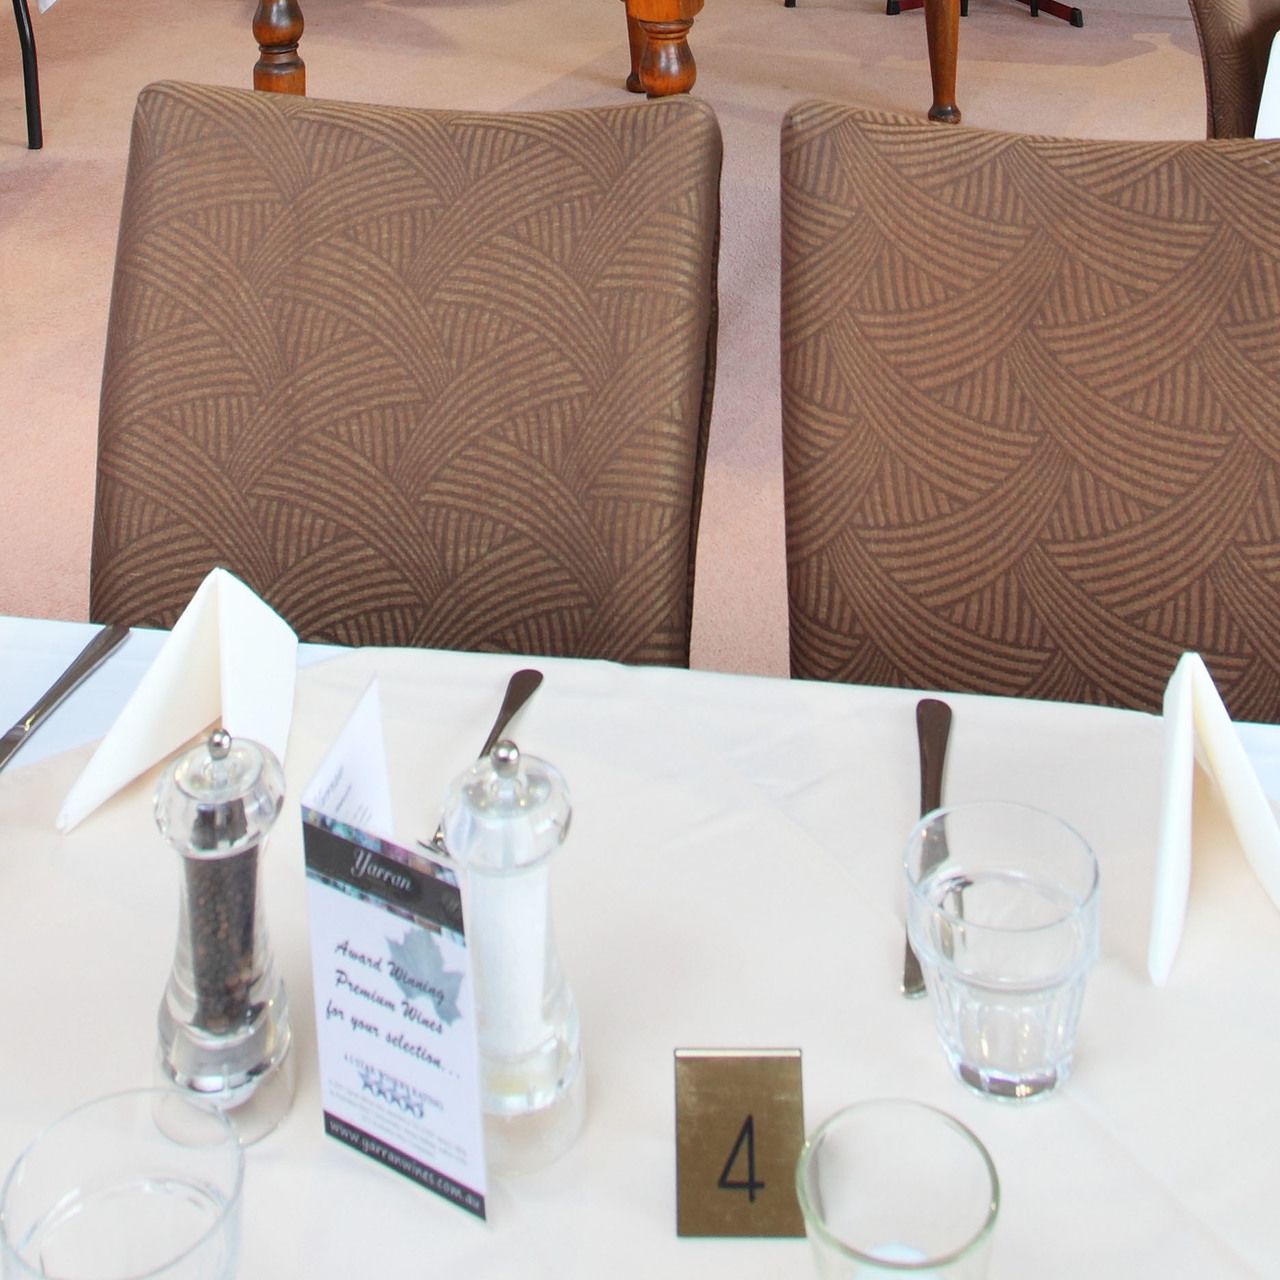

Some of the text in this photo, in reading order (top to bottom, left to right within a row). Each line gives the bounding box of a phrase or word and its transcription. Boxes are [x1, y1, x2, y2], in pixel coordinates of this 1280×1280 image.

[350, 848, 413, 892] Yarran
[334, 940, 446, 1005] Award Winning
[335, 968, 444, 1035] Premium Wines
[325, 999, 345, 1020] for
[350, 1016, 380, 1038] your
[329, 1122, 481, 1209] www.yarranwines.com.au
[717, 1114, 765, 1203] 4
